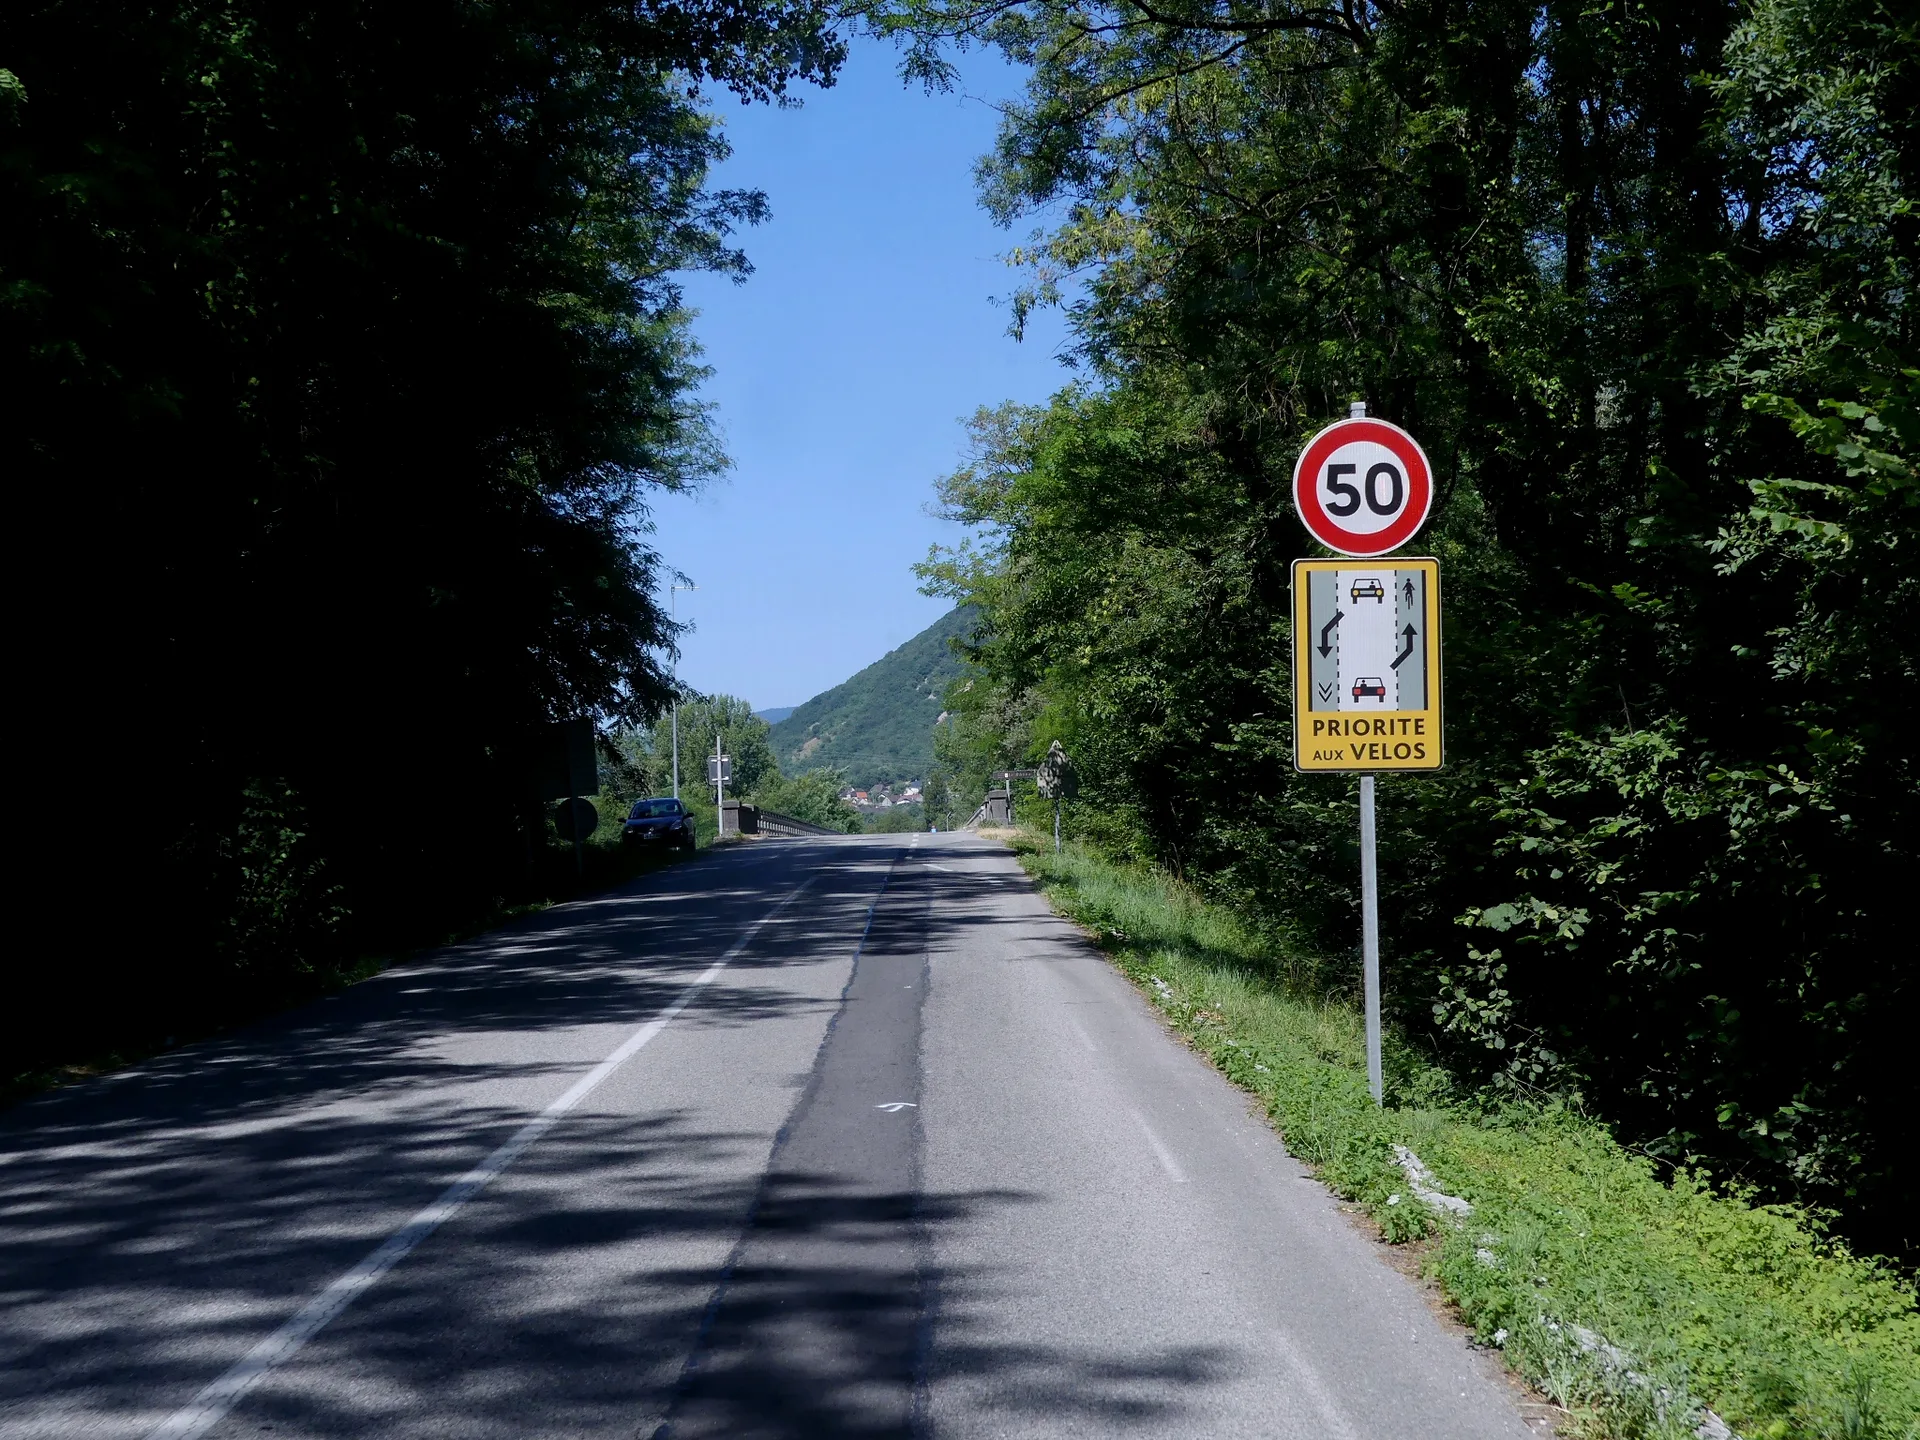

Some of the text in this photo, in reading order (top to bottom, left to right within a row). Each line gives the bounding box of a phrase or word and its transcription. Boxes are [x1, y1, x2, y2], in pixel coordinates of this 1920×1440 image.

[1325, 462, 1404, 517] 50
[1313, 718, 1425, 736] PRIORITE
[1312, 742, 1426, 761] AUX VELOS
